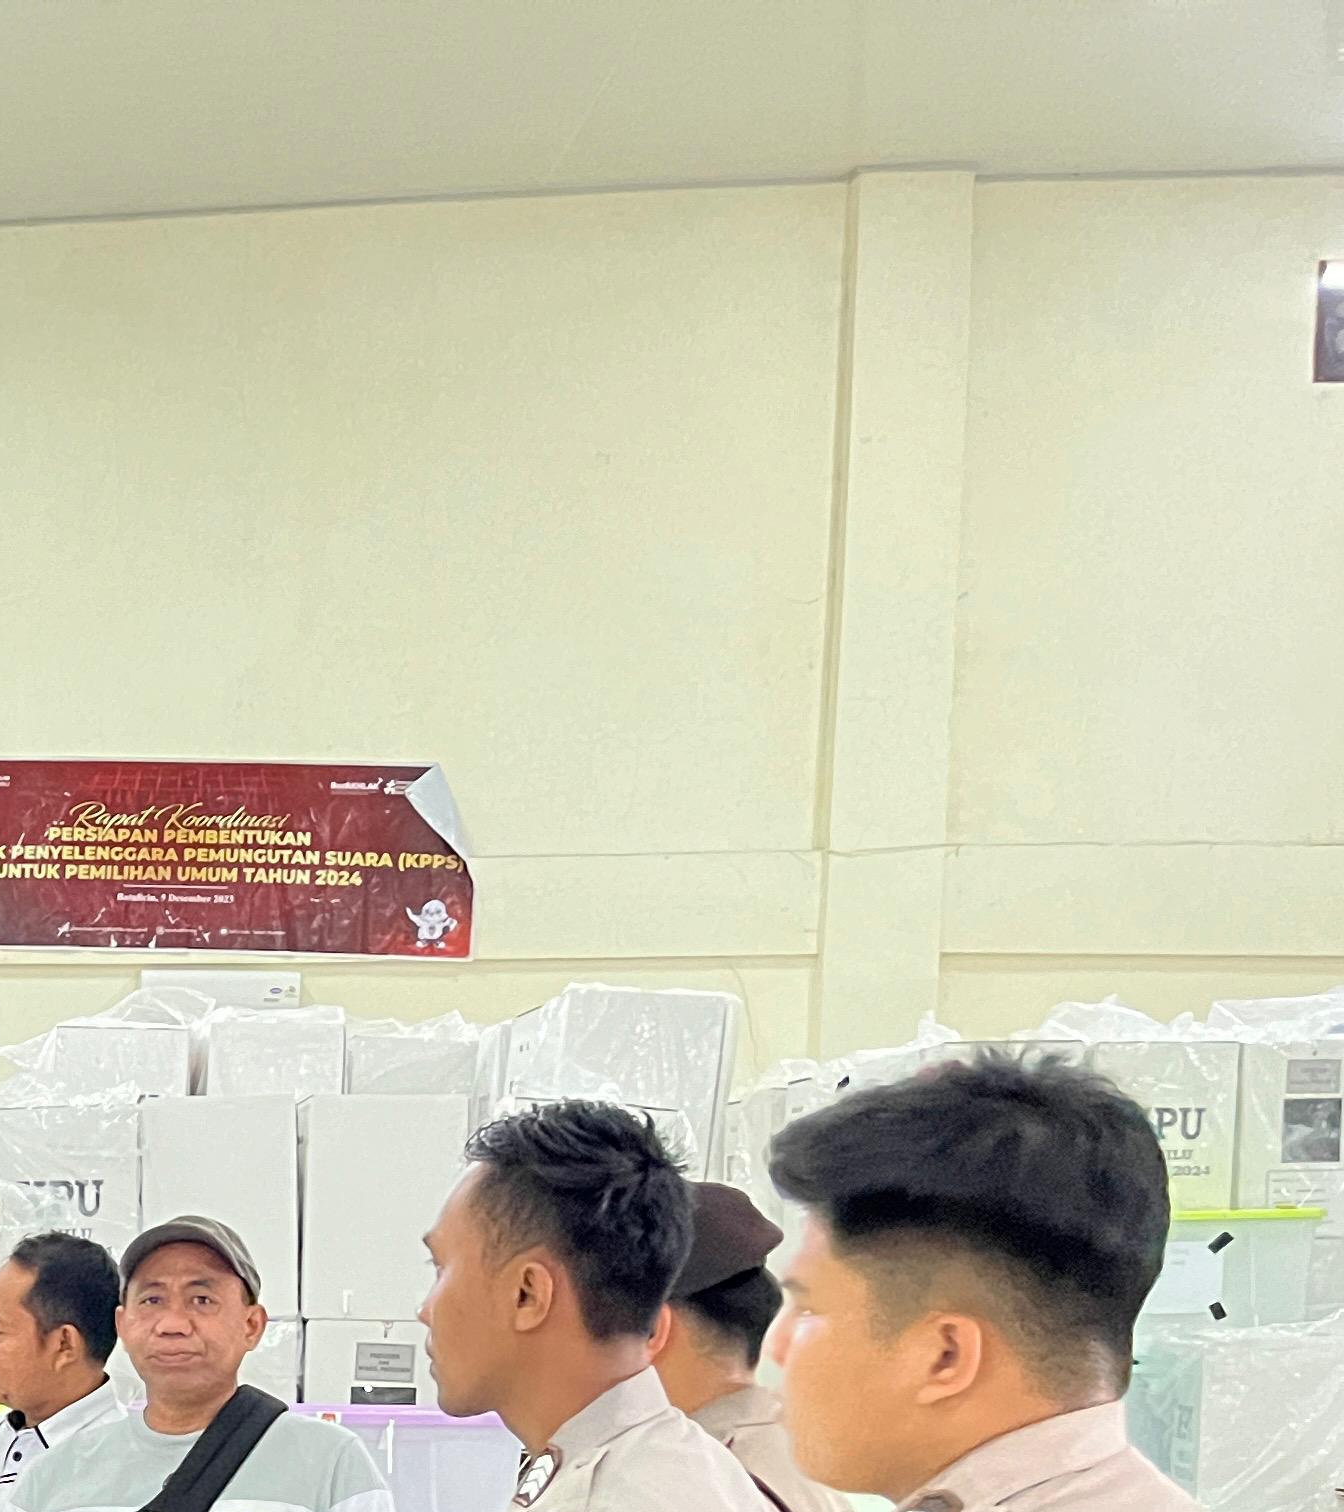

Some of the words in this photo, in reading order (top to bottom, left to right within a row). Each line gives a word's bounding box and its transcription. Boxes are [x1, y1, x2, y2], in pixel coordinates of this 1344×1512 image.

[69, 801, 155, 835] Rapat
[155, 802, 292, 830] Koordinasi
[48, 827, 157, 844] PERSIAPAN
[164, 829, 312, 847] PEMBENTUKAN
[11, 846, 178, 863] PENYELENGGARA
[184, 848, 321, 866] PEMUNGUTAN
[325, 852, 393, 868] SUARA
[65, 864, 172, 882] PEMILIHAN
[177, 866, 238, 884] UMUM
[243, 868, 311, 886] TAHUN
[315, 870, 363, 887] 2024
[1153, 1106, 1207, 1140] PU
